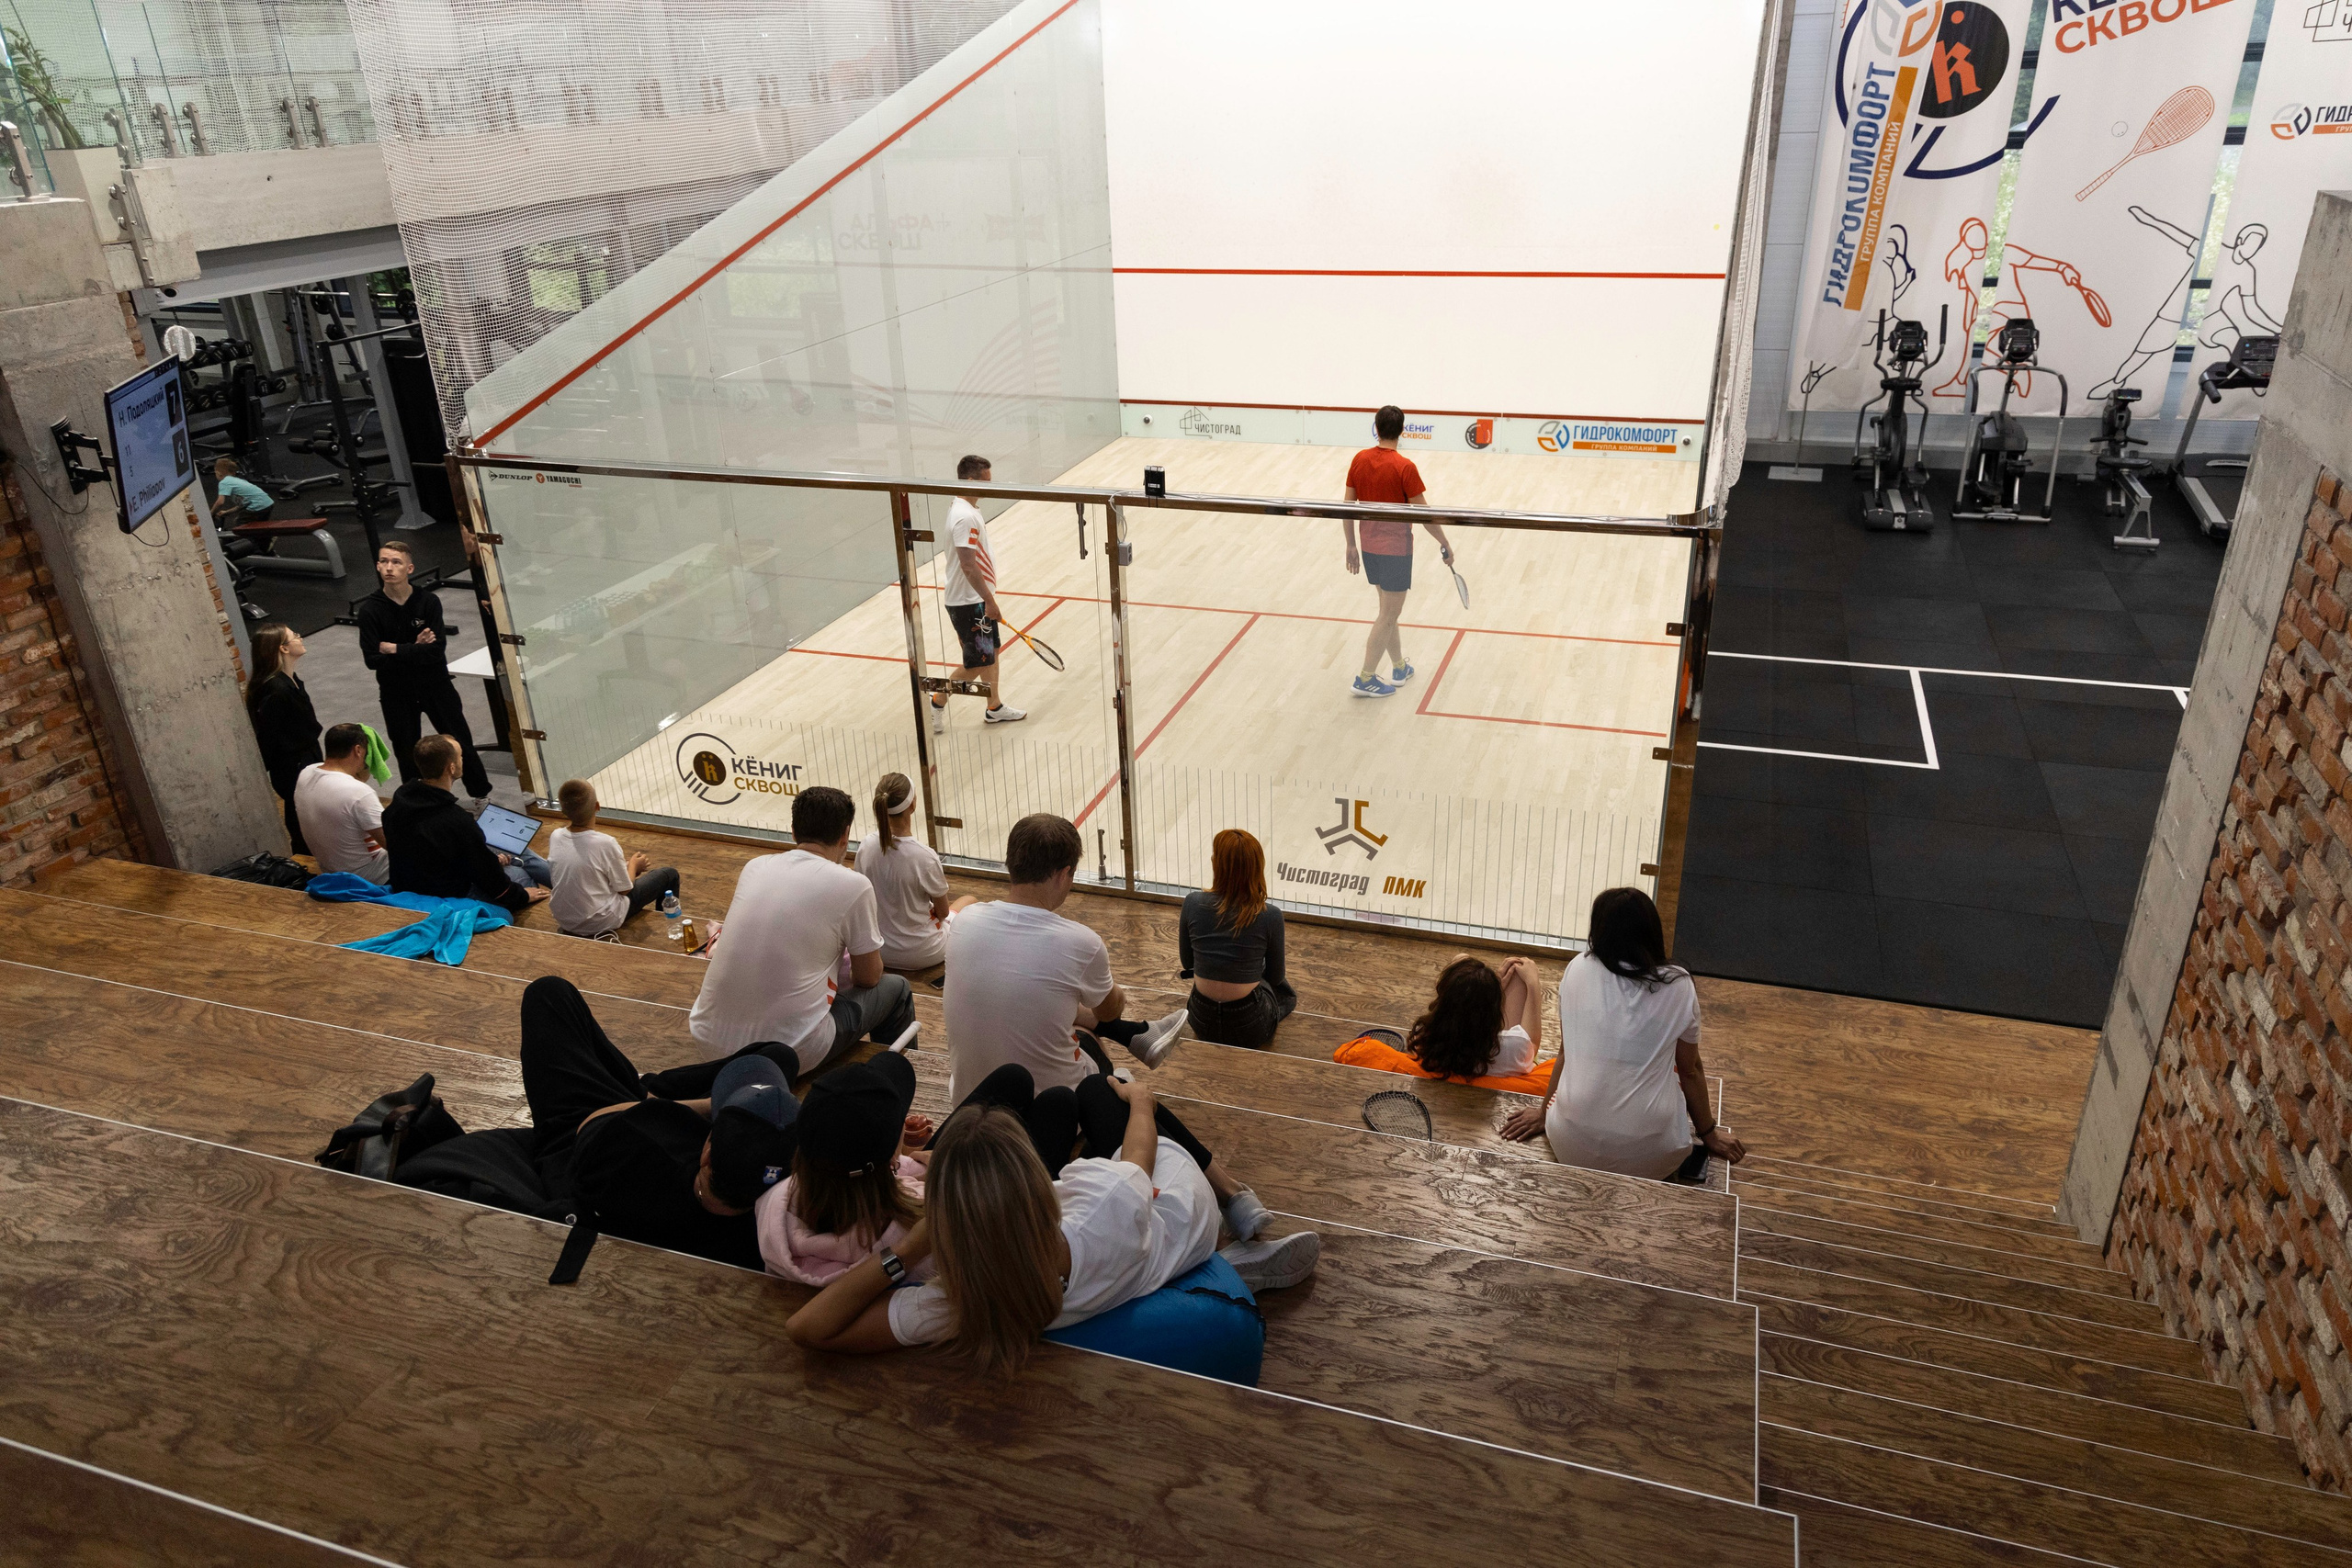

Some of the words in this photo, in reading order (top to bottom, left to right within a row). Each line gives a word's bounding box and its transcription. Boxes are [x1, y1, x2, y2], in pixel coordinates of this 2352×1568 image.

[1860, 209, 1882, 262] ГРУППА
[1871, 120, 1902, 205] КОМПАНИЙ
[1194, 423, 1241, 435] ЧИСТОГРАД
[1401, 432, 1432, 440] СКВОШ
[1573, 424, 1678, 444] ГИДРОКОМФОРТ
[177, 441, 185, 464] 6
[546, 475, 582, 484] YAMAGUCHI
[730, 755, 802, 781] КЁНИГ
[733, 777, 800, 796] СКВОШ
[1276, 862, 1370, 896] Чистоград
[1382, 875, 1427, 898] ПМК
